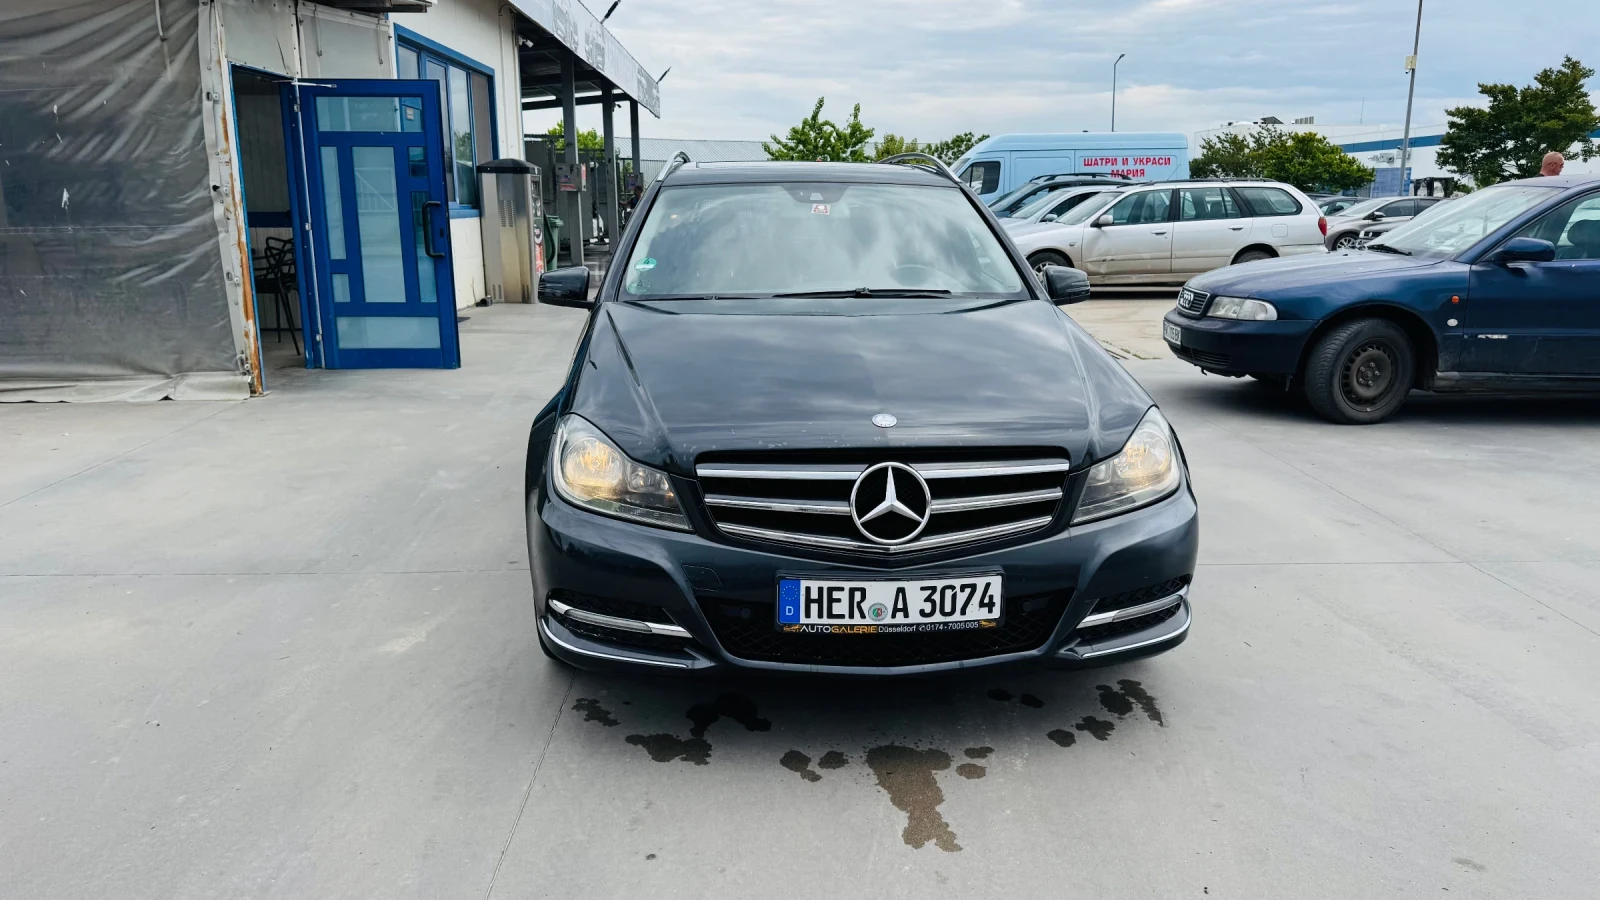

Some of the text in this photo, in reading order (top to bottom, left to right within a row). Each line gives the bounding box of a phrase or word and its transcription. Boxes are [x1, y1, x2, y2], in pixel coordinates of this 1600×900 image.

[1083, 157, 1171, 166] ШАТРИ И УКРАСИ
[1111, 169, 1145, 177] МАРИЯ
[804, 586, 867, 619] HER
[891, 587, 909, 619] A
[919, 582, 996, 618] 3074
[785, 606, 794, 616] D
[800, 625, 877, 633] AUTOGALERIE
[878, 625, 916, 633] Düsseldorf
